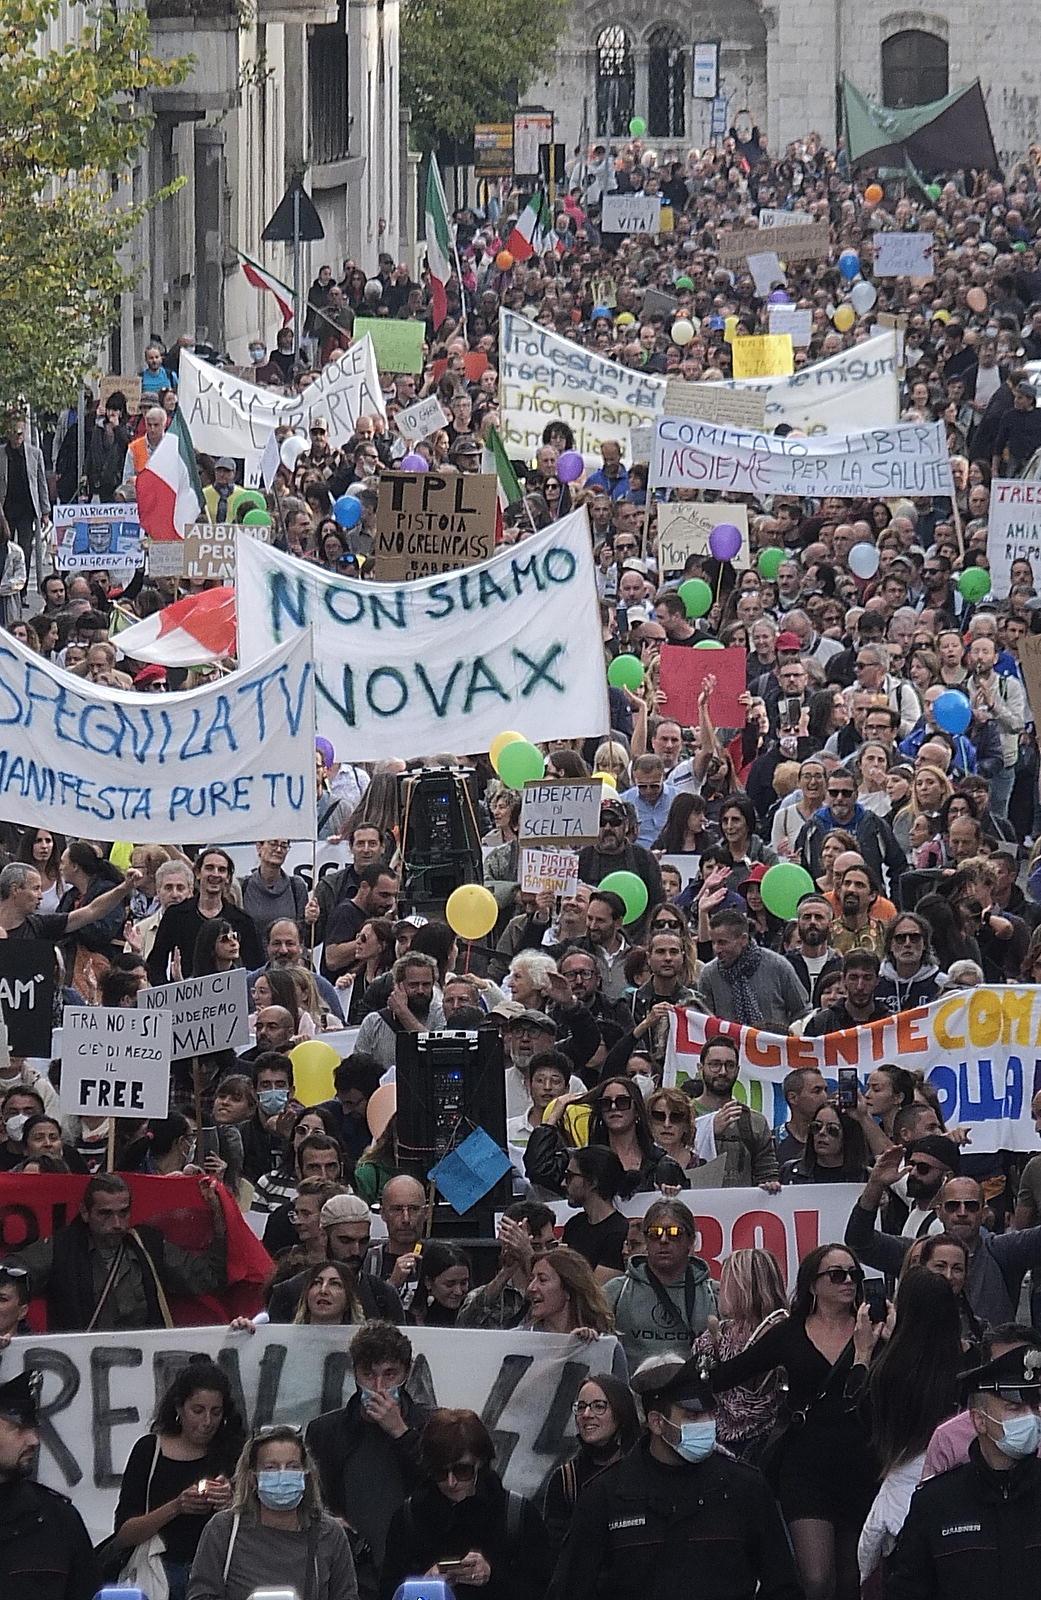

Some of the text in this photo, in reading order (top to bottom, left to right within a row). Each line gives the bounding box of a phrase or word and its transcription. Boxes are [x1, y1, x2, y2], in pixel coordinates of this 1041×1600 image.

[618, 213, 654, 231] VITA!
[658, 421, 809, 457] COMITATO
[846, 421, 942, 455] LIBERI
[659, 448, 951, 491] INSIEME PER LA SALUTE
[57, 508, 76, 519] NO
[396, 513, 466, 532] PISTOIA
[379, 531, 404, 553] NO
[57, 555, 77, 567] NO
[199, 544, 235, 560] PER
[266, 547, 577, 644] NON SIAMO
[237, 661, 314, 743] TV
[168, 775, 254, 822] PURE
[261, 772, 305, 810] TU
[552, 805, 563, 815] DI
[524, 818, 584, 837] SCELTA
[147, 976, 231, 1009] NOI NON CI
[70, 1013, 98, 1031] TRA
[107, 1014, 126, 1032] NO
[131, 1019, 136, 1030] E
[745, 1006, 931, 1069] GENTE
[107, 1045, 119, 1057] DI
[125, 1045, 163, 1061] MEZZO
[105, 1063, 117, 1072] IL
[79, 1078, 145, 1110] FREE
